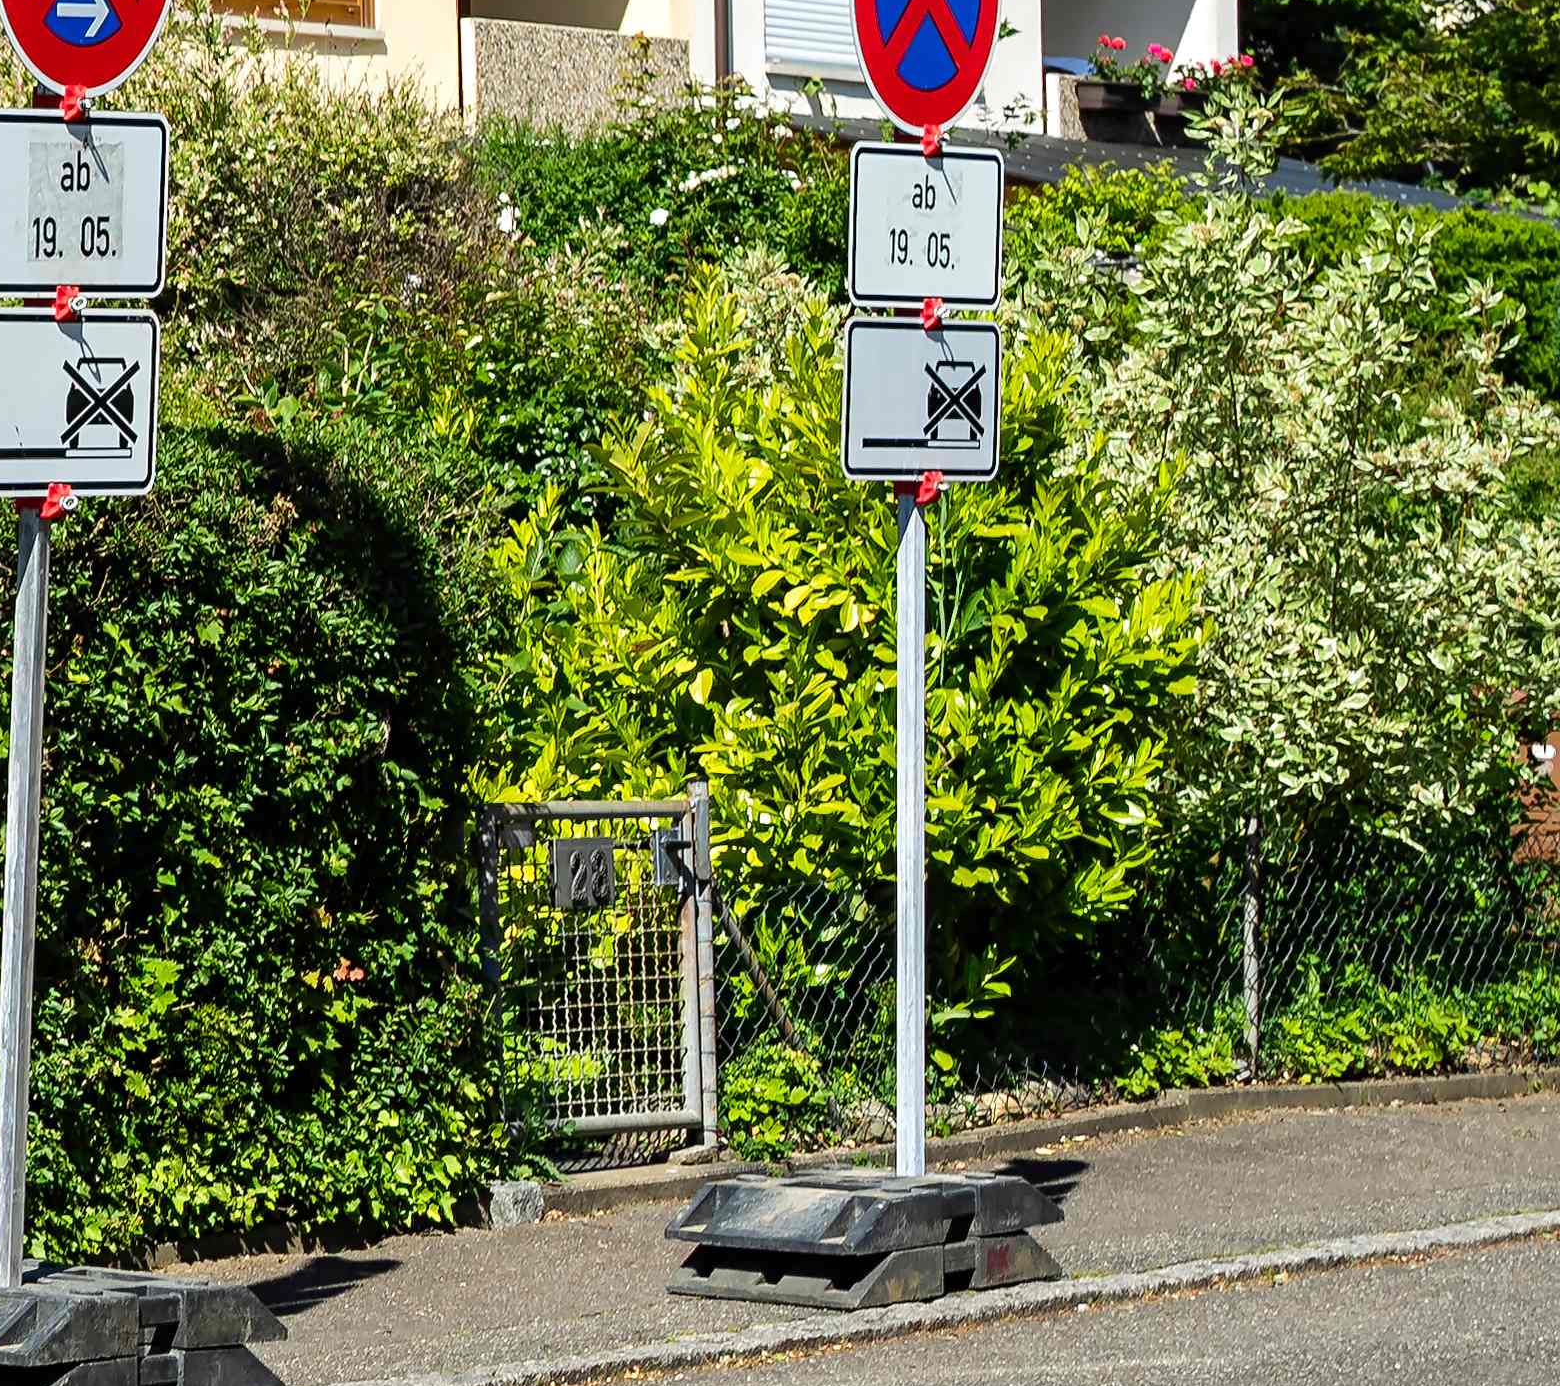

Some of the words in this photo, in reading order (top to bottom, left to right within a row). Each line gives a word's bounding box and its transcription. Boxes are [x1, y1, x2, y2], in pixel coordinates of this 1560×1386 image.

[60, 150, 91, 192] ab
[912, 174, 936, 210] ab
[32, 216, 63, 258] 19.
[80, 216, 116, 257] 05.
[889, 227, 913, 265] 19.
[927, 231, 955, 270] 05.
